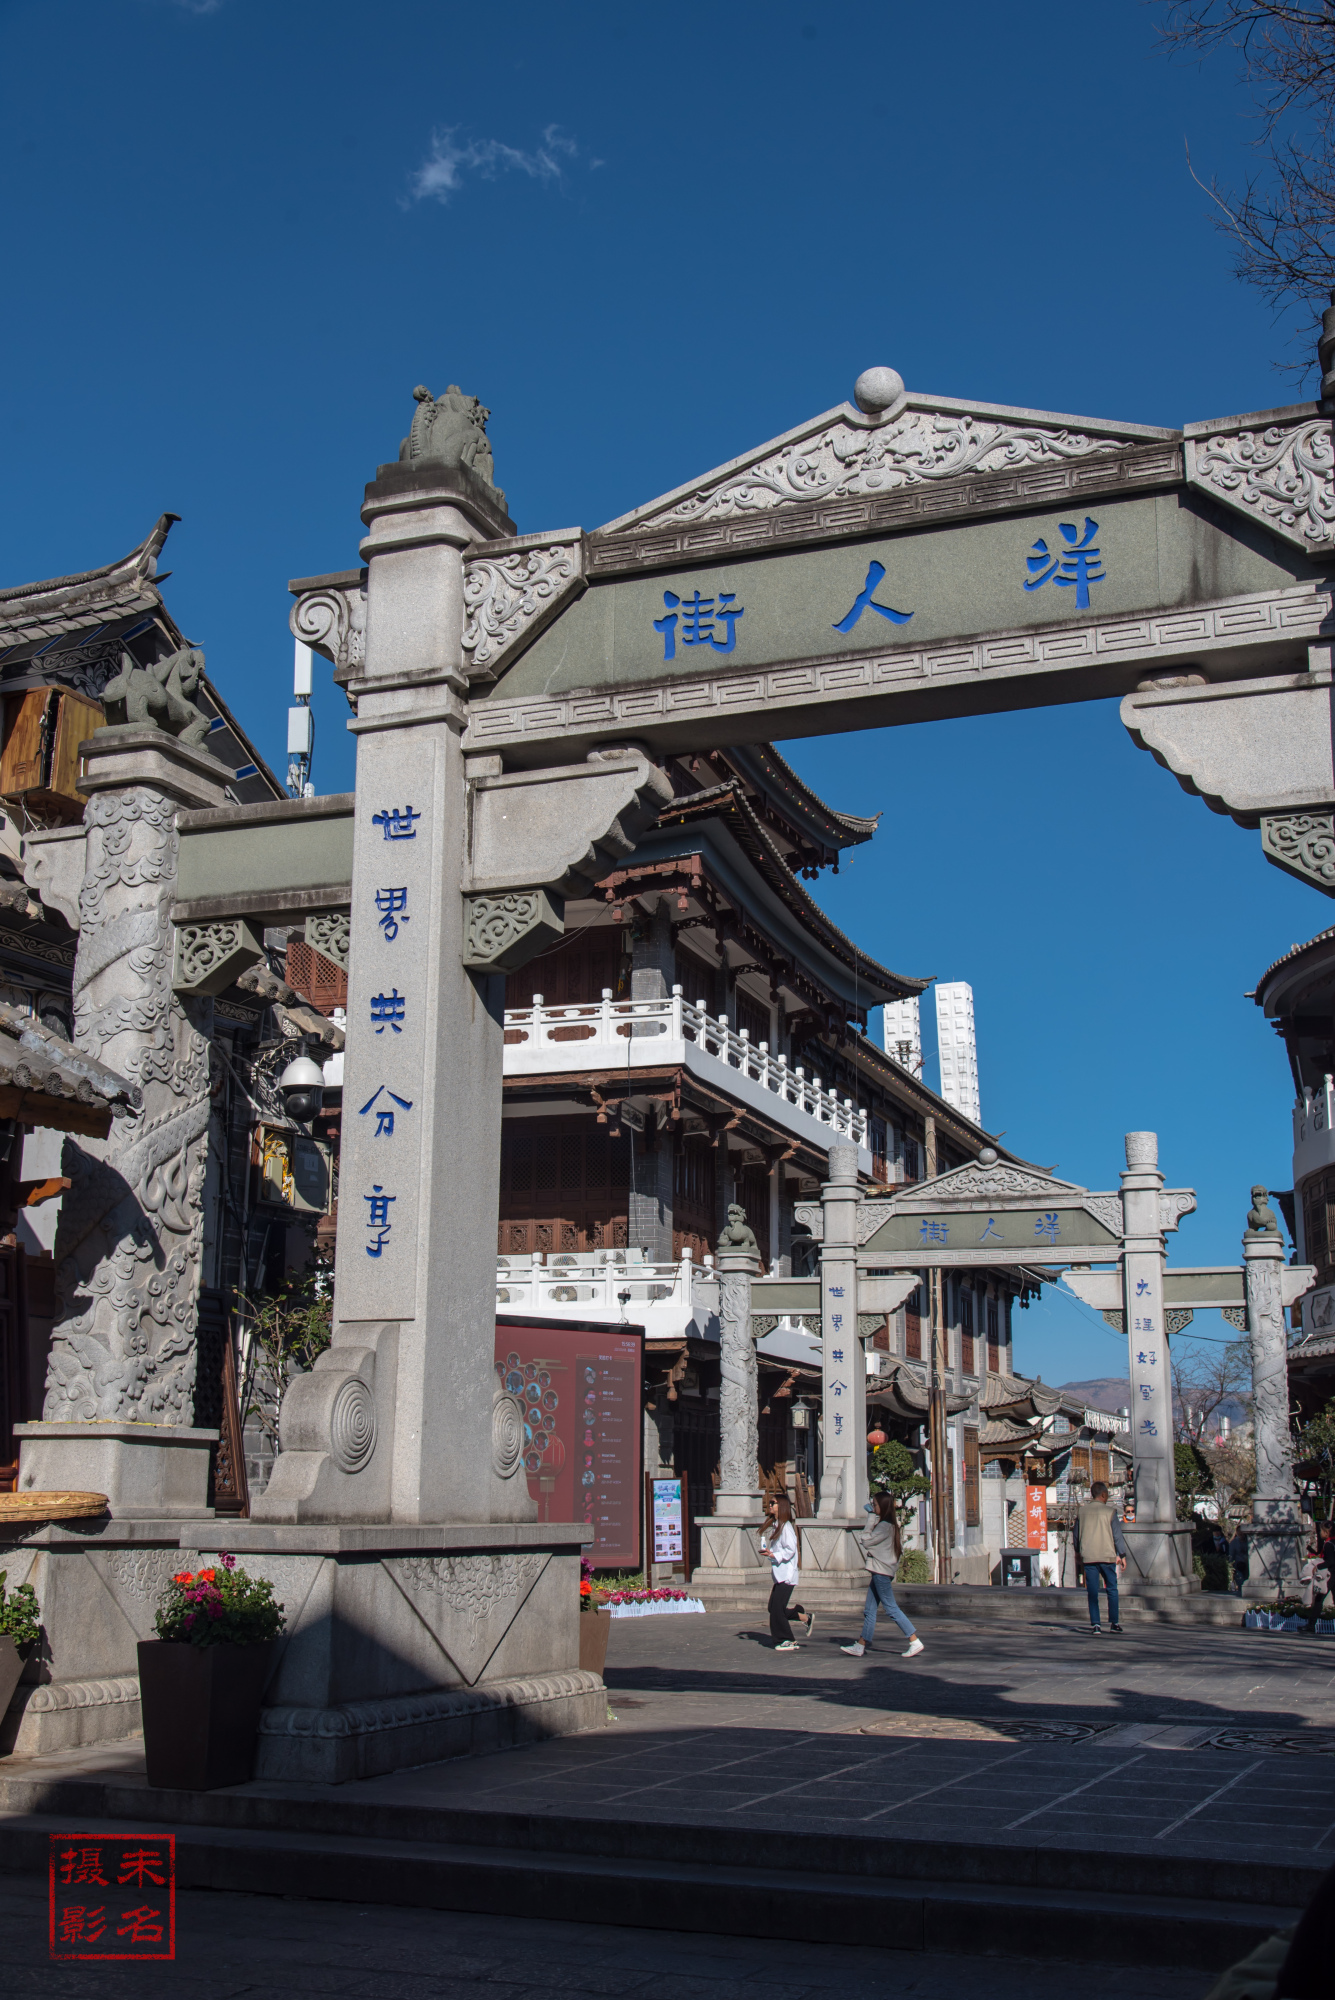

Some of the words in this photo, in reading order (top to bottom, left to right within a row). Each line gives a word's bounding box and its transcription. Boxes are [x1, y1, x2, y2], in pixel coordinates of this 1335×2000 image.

[358, 805, 422, 1258] 世界共分享
[829, 1286, 848, 1436] 世界共分享
[1030, 1487, 1043, 1520] 古妍
